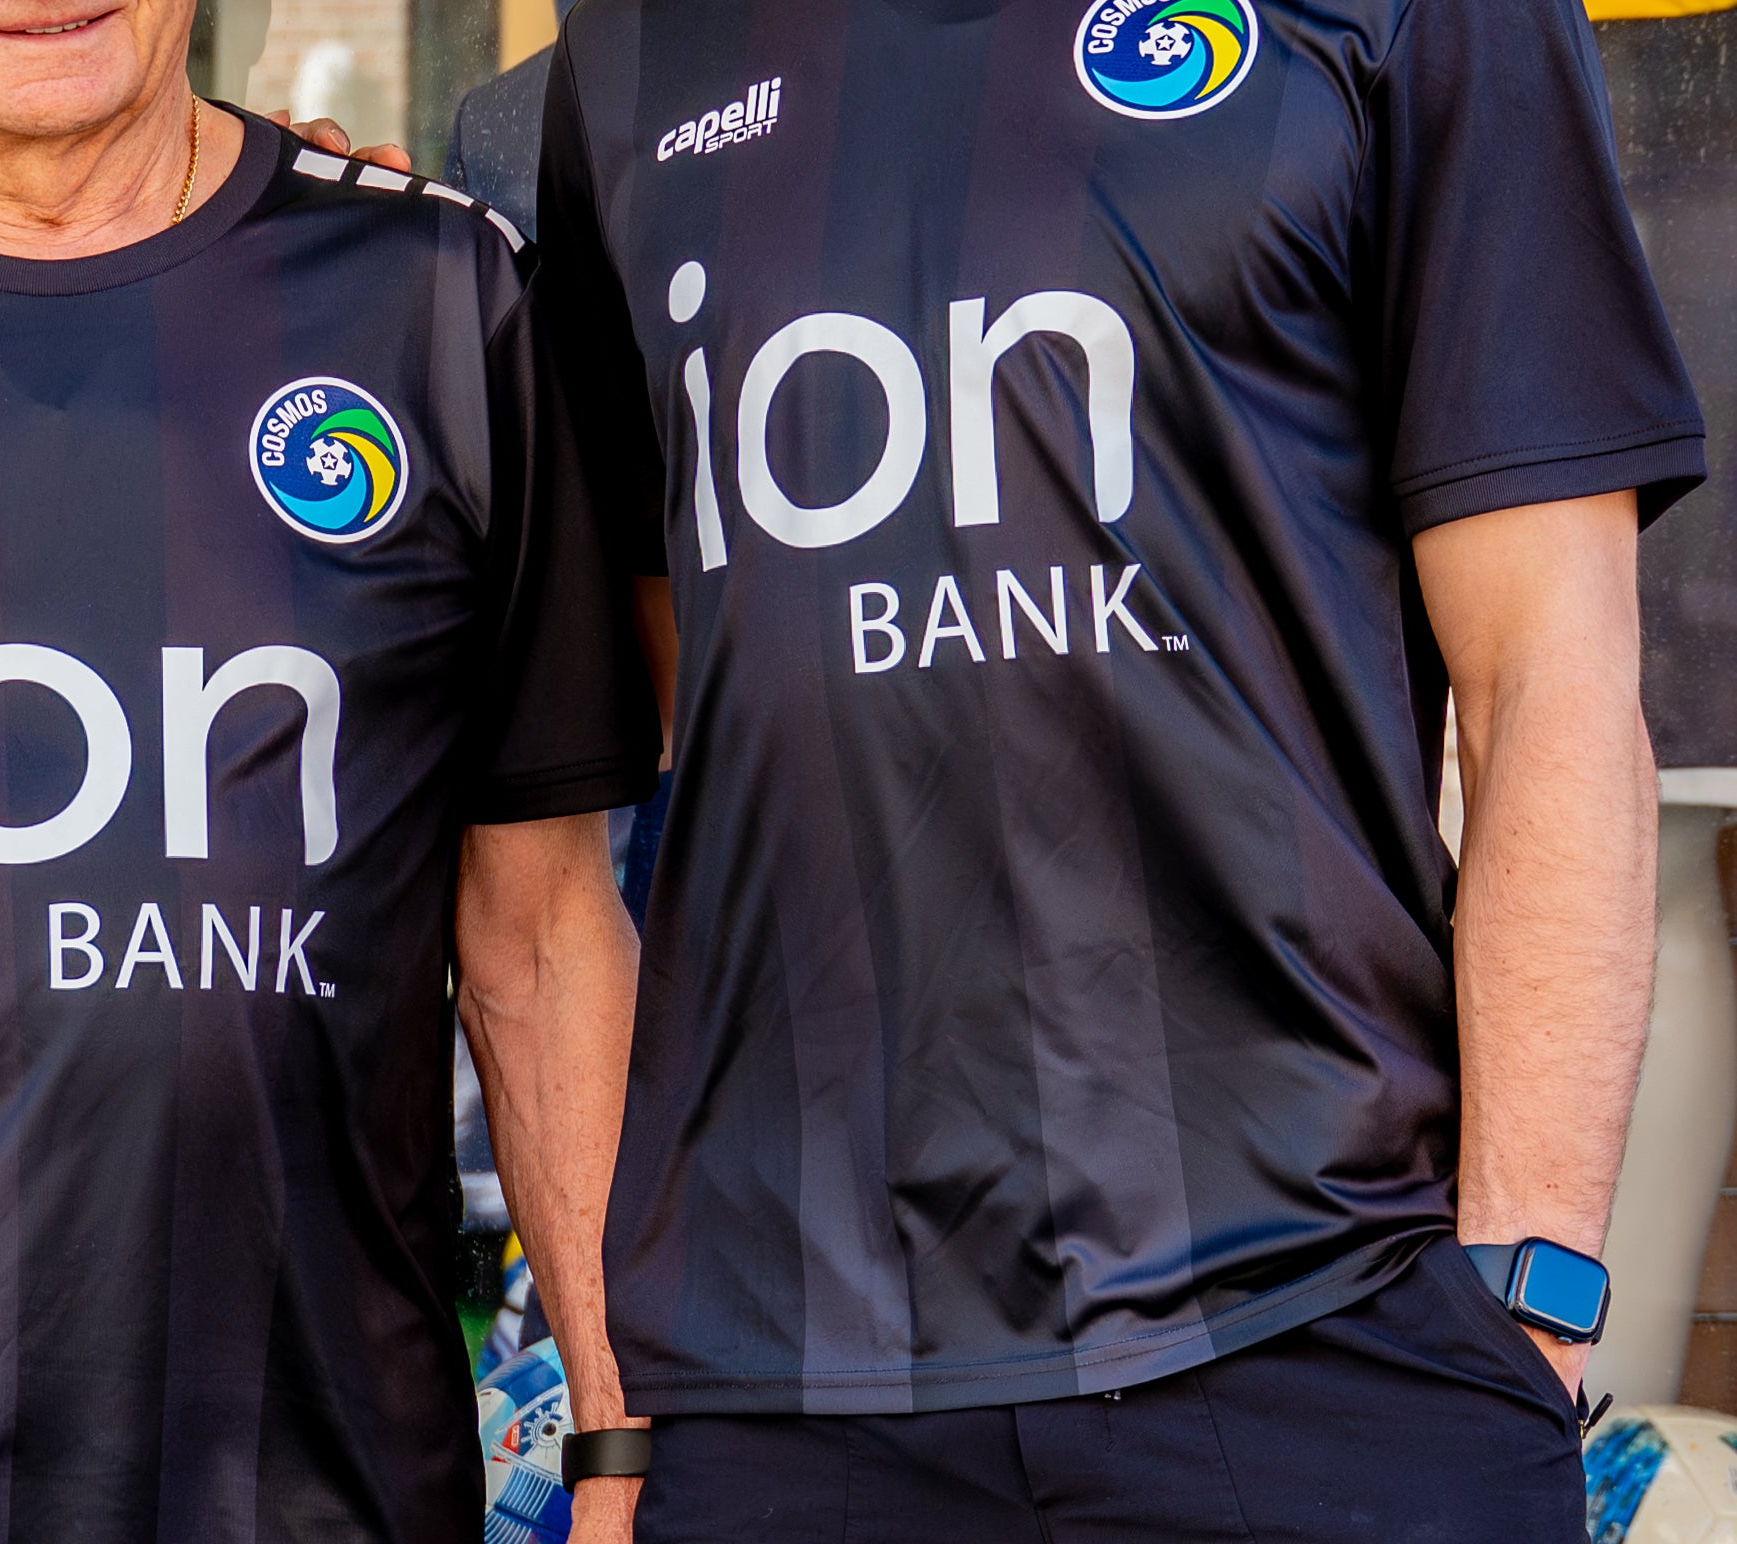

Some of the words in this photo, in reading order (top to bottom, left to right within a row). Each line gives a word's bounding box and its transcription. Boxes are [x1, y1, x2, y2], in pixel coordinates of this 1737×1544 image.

[657, 76, 782, 162] capelli
[704, 117, 778, 154] SPORT
[261, 389, 328, 467] COSMOS
[667, 260, 1135, 573] ion
[848, 562, 1159, 674] BANK
[47, 901, 326, 996] BANK
